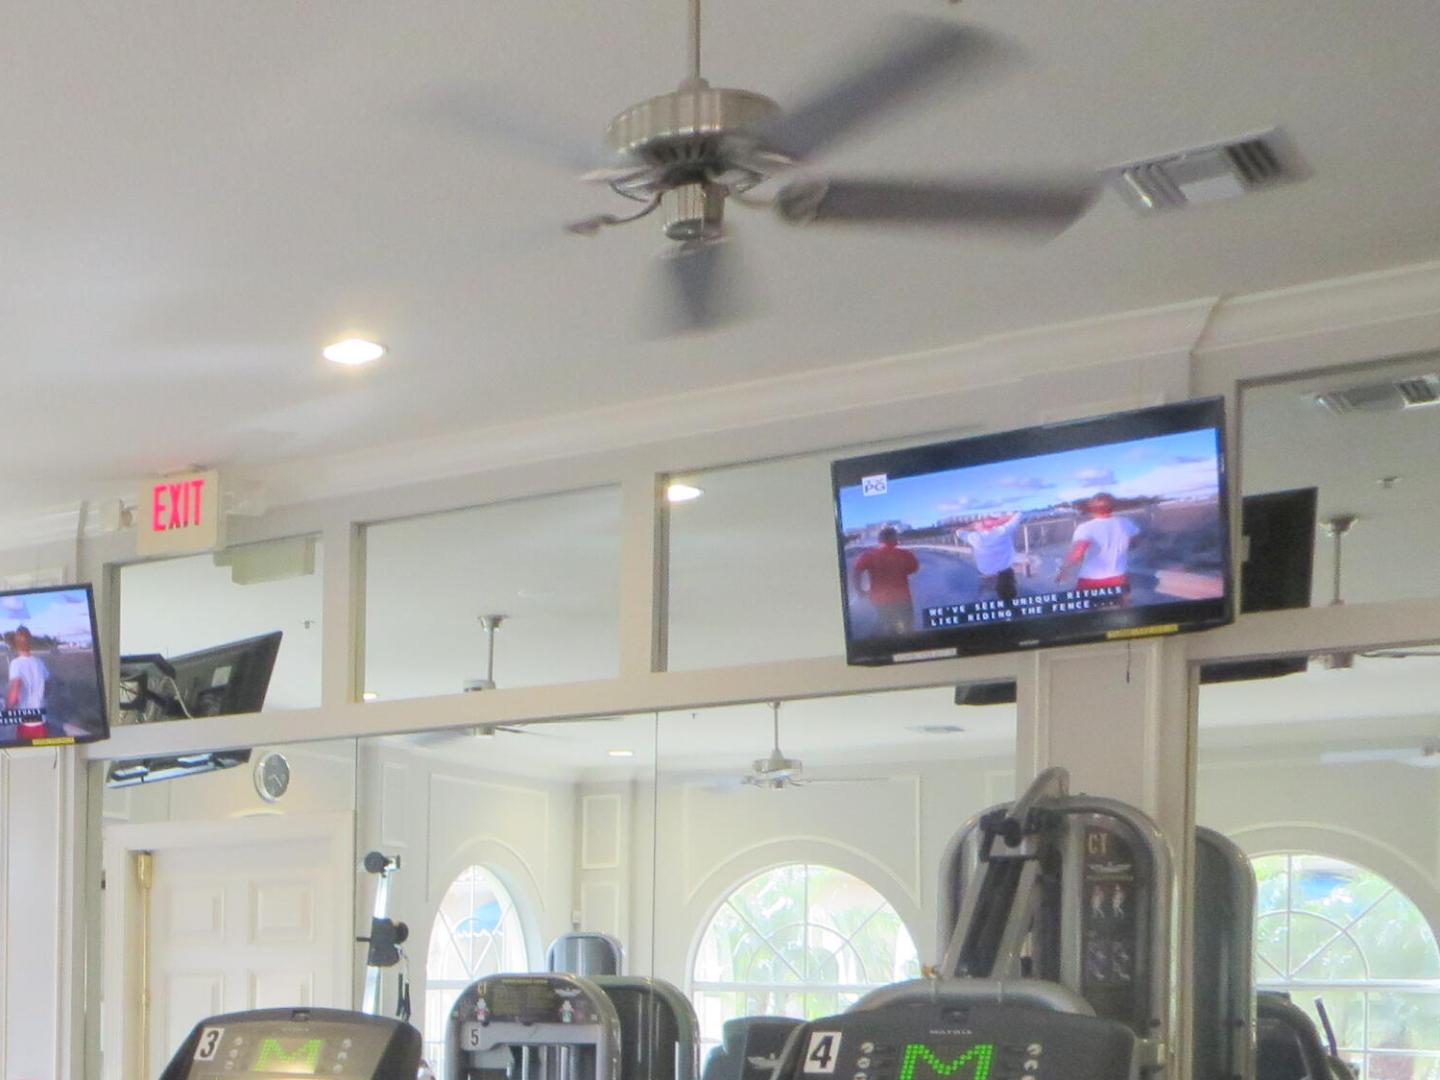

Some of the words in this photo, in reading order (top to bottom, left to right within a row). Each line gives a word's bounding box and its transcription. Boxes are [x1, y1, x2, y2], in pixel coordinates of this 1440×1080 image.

[865, 481, 886, 493] PG
[153, 480, 205, 532] EXIT
[929, 605, 965, 616] WE'VE
[975, 601, 1004, 611] SEEN
[1012, 594, 1057, 606] UNIQUE
[1067, 586, 1122, 599] RITUALS
[931, 616, 958, 626] LIKE
[968, 610, 1012, 622] RIDING
[1021, 605, 1042, 615] THE
[199, 1030, 219, 1058] 3
[471, 1029, 479, 1046] 5
[809, 1035, 833, 1069] 4
